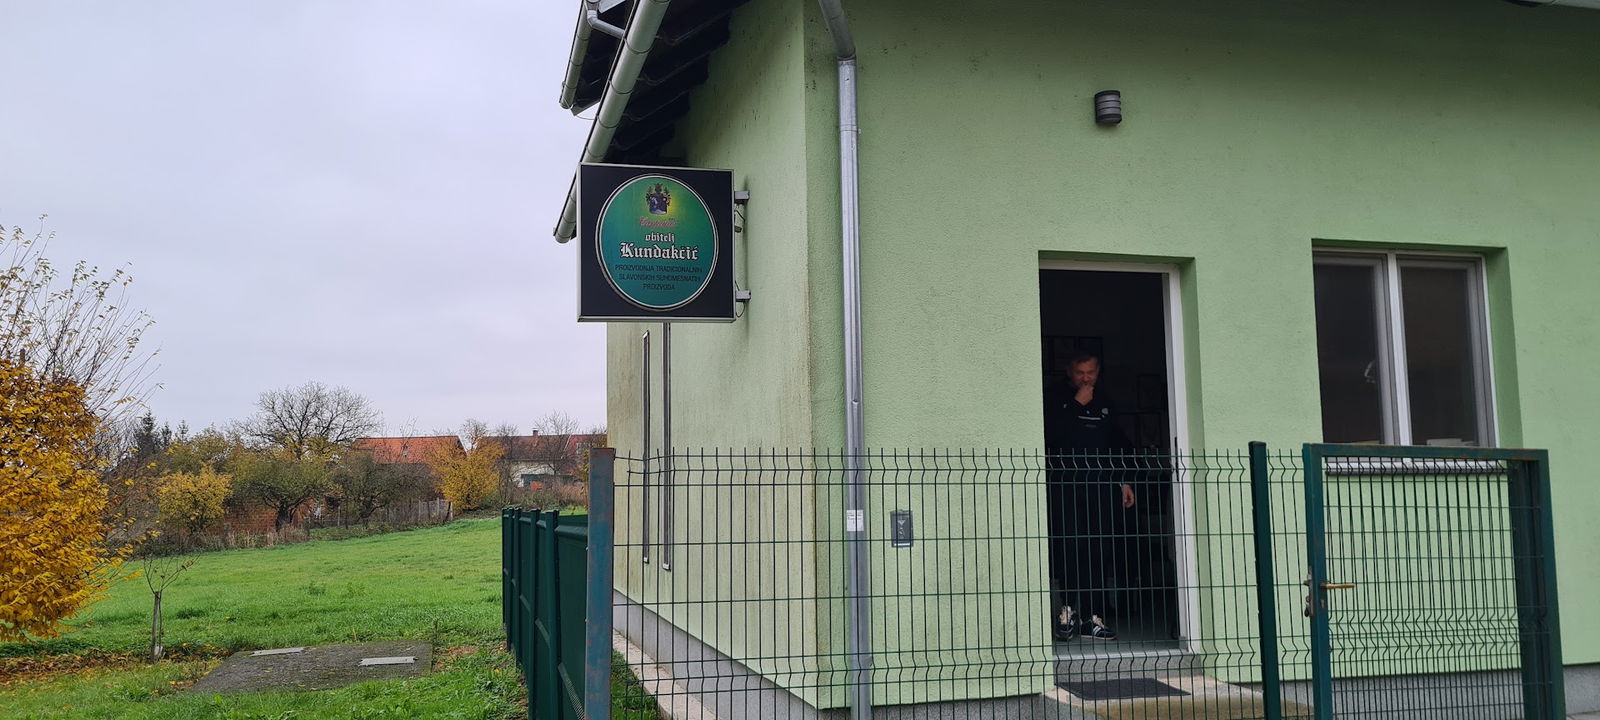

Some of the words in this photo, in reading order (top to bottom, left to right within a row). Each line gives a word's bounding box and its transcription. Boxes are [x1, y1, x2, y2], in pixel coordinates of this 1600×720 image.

[645, 232, 675, 243] obitelj
[614, 264, 654, 272] PROIZVODNJA
[656, 265, 703, 273] TRADICIONALNIH
[656, 274, 701, 282] SUHOMESNATIH
